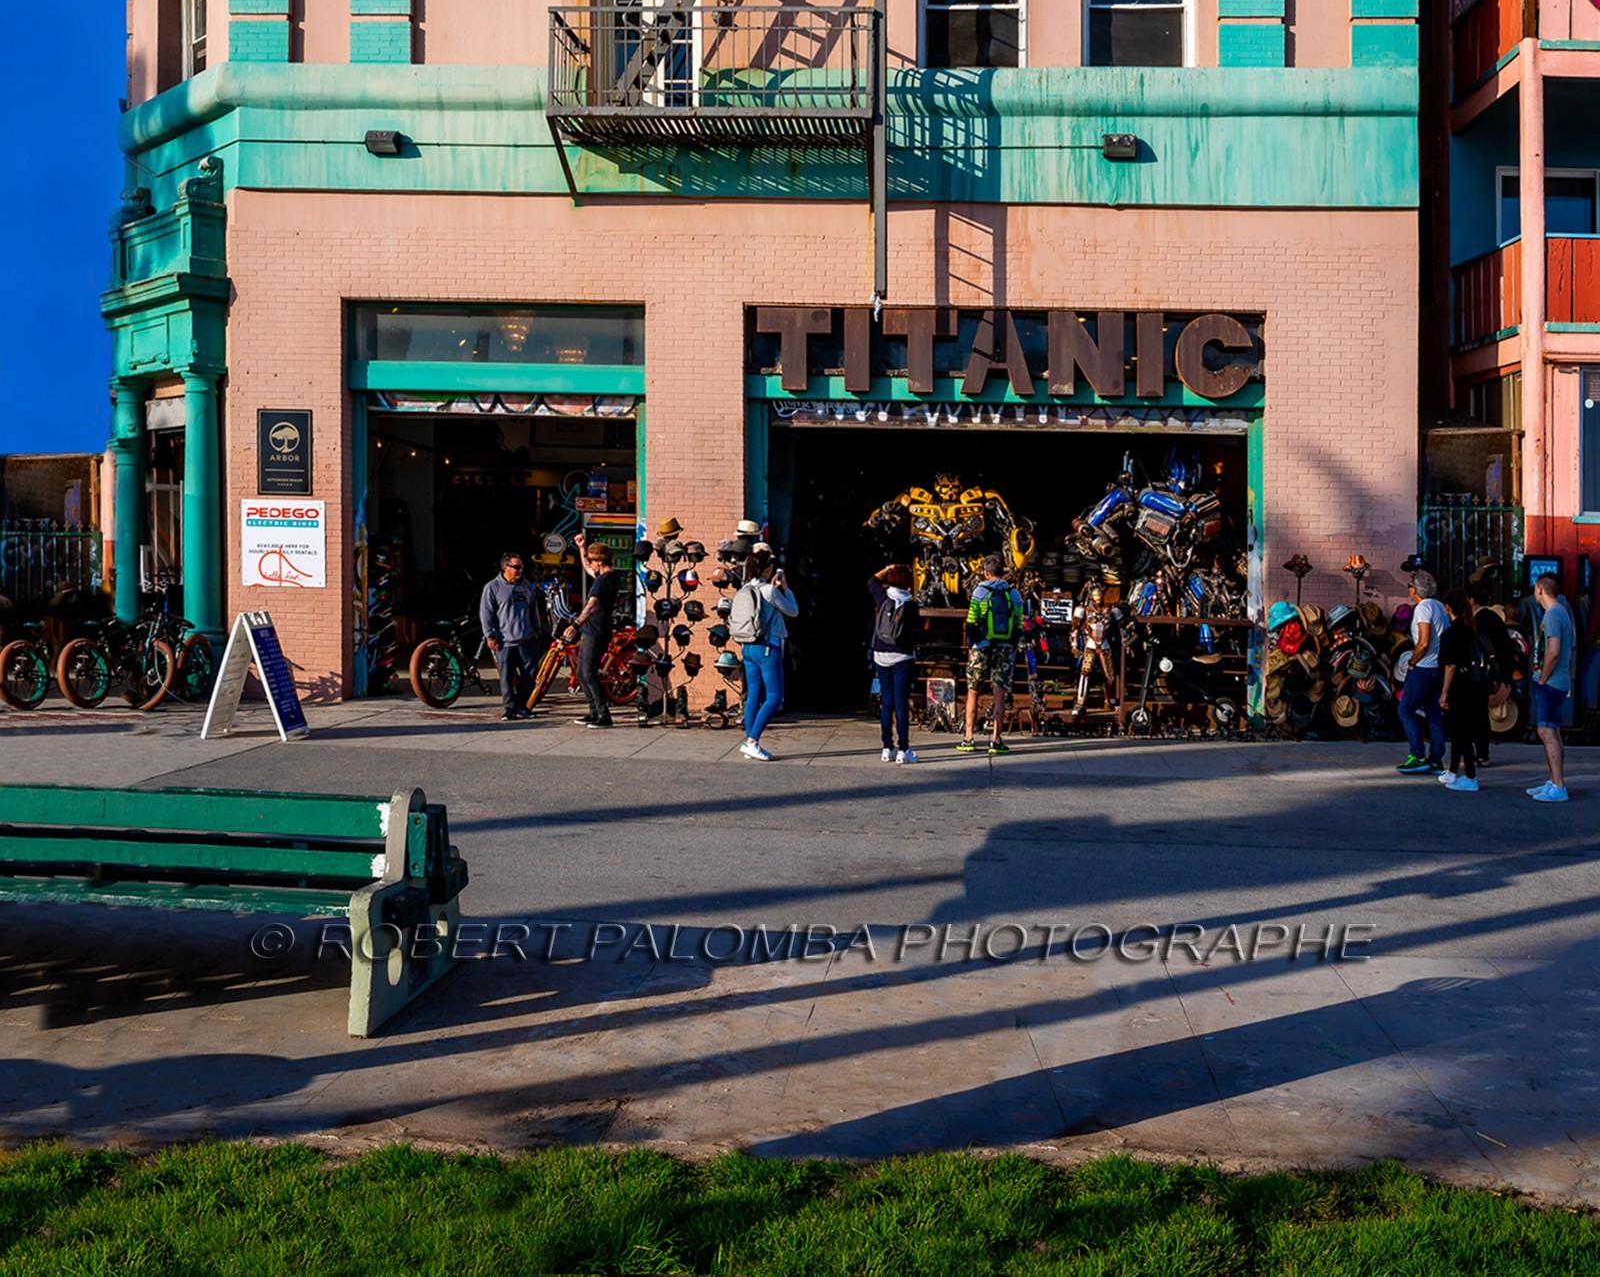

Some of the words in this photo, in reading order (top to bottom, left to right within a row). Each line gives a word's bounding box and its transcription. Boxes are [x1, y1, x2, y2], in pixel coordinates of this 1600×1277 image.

[756, 306, 1254, 398] TITANIC
[269, 454, 300, 462] ARBOR
[246, 507, 319, 518] PEDEGO
[1531, 566, 1557, 575] ATM
